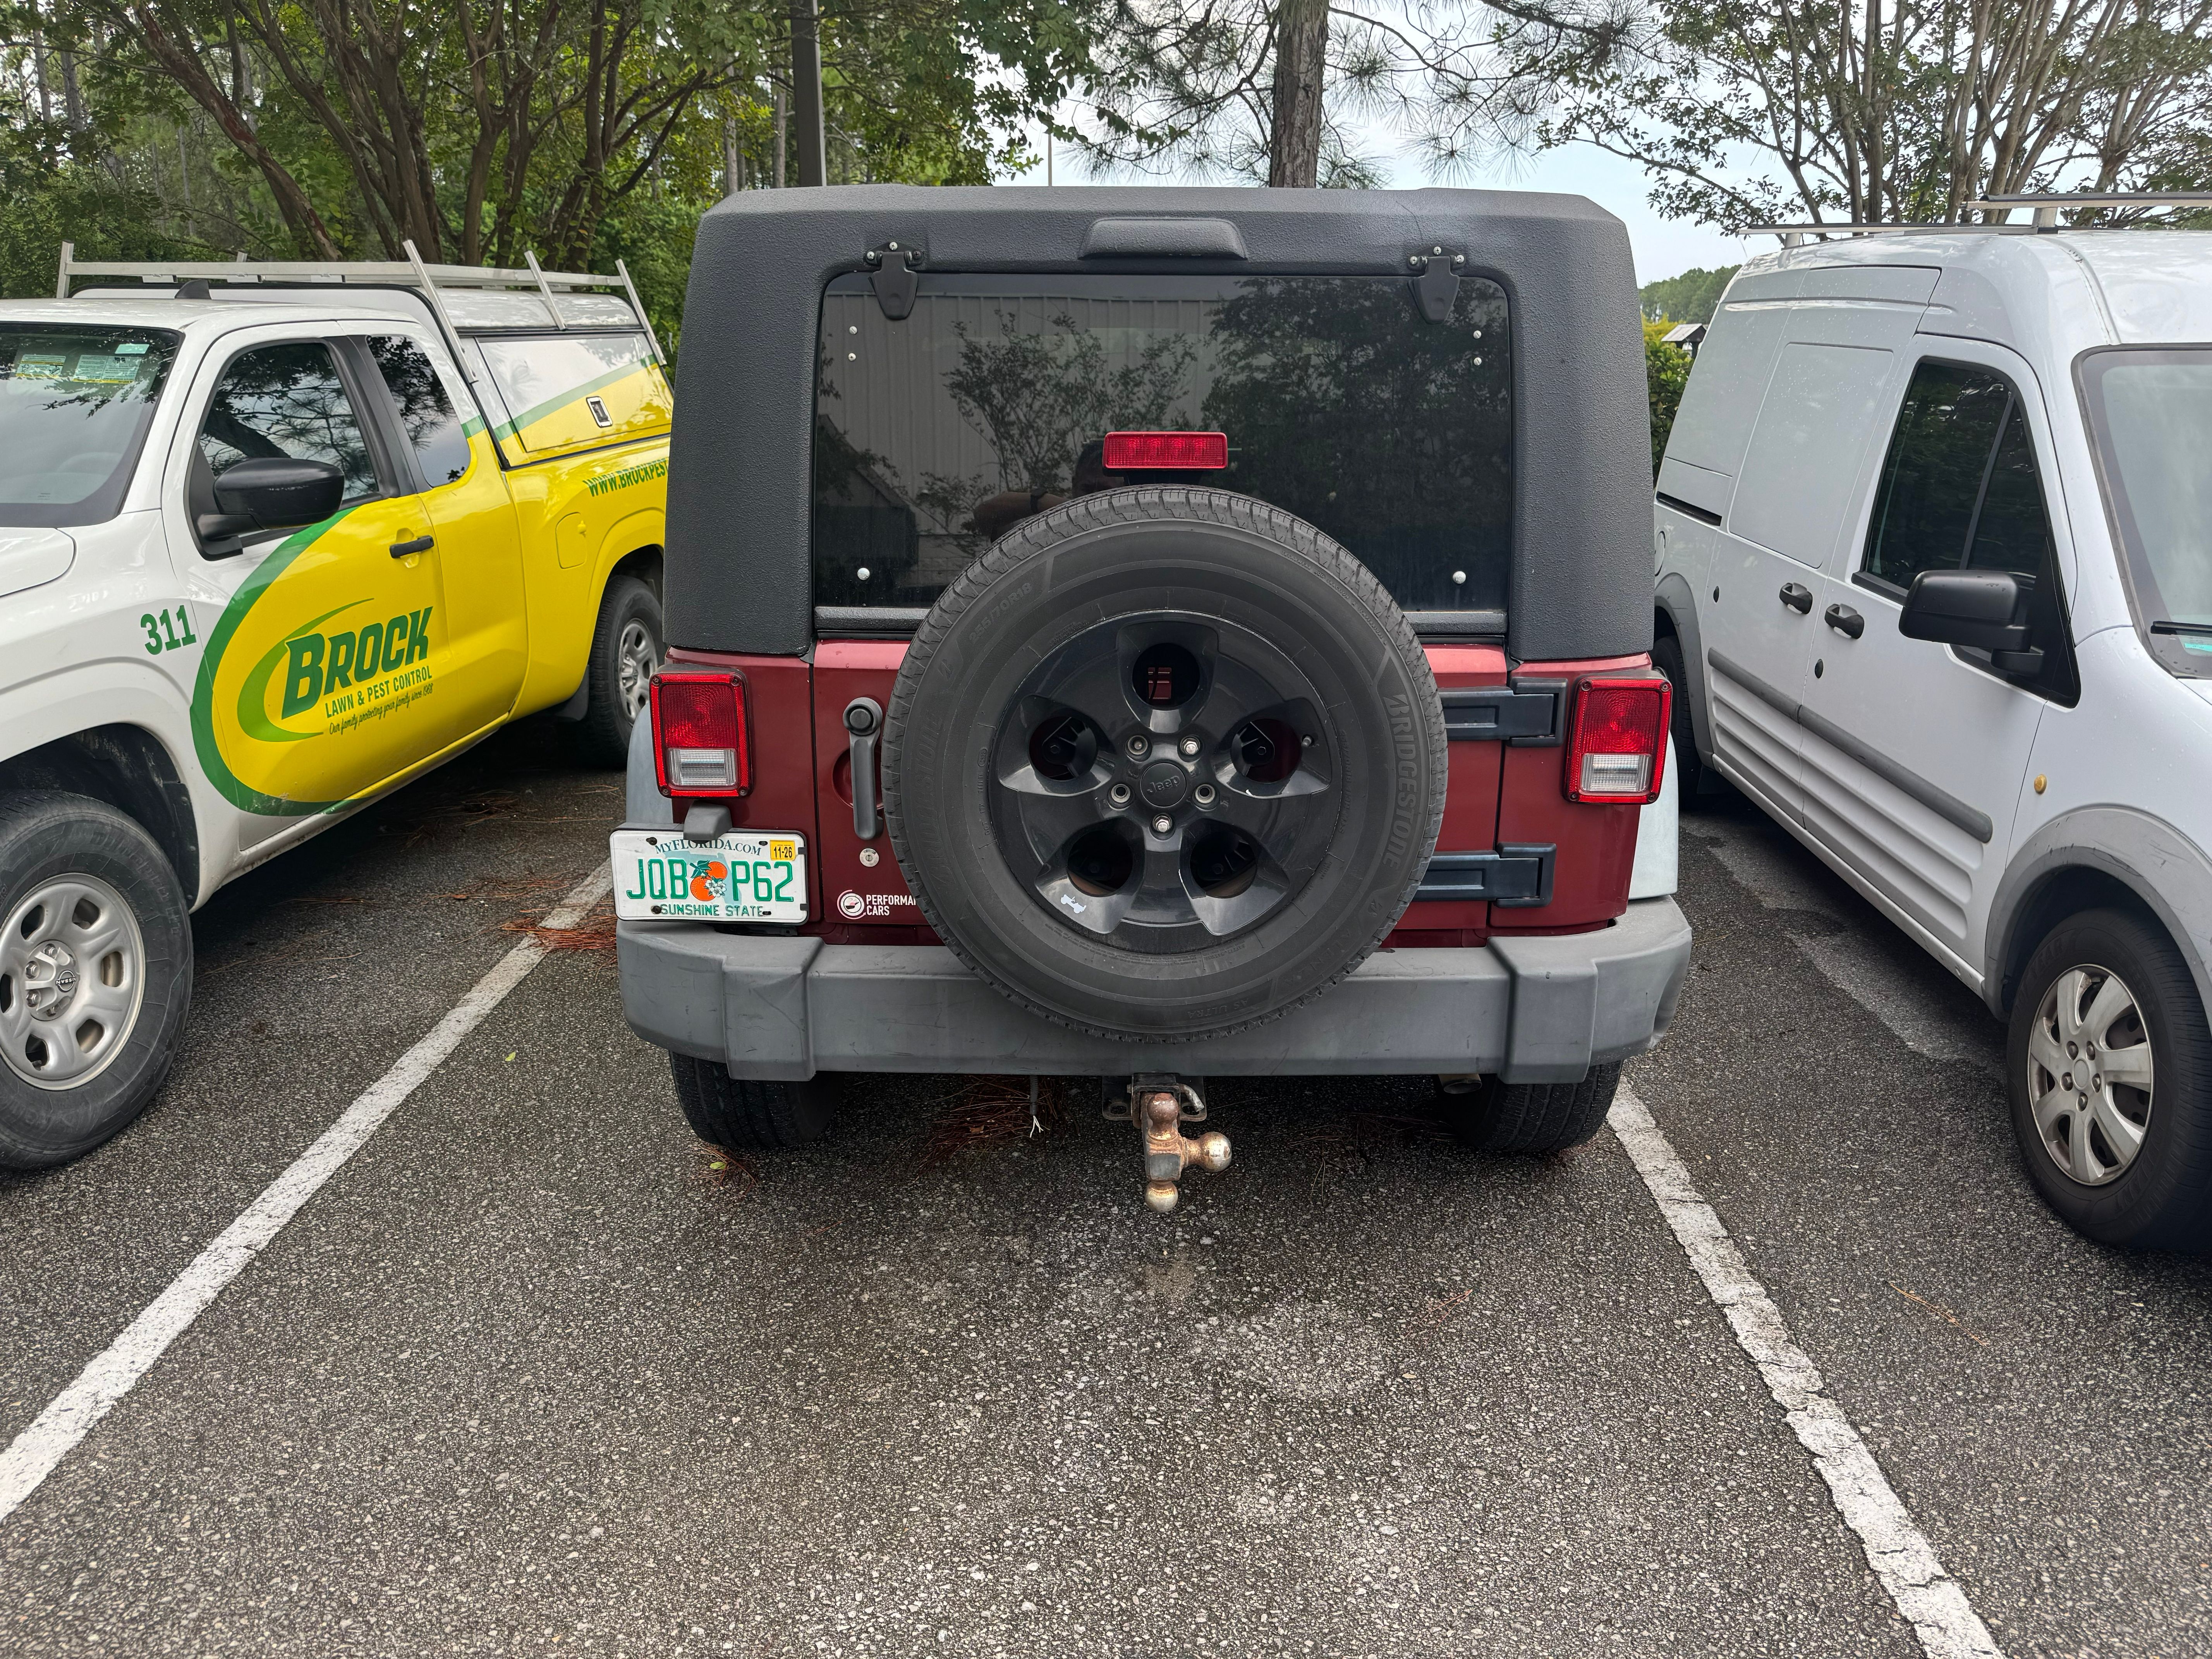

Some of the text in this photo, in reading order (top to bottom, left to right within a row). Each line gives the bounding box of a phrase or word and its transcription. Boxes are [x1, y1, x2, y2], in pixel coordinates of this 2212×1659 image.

[141, 605, 196, 655] 311
[282, 606, 433, 720] BROCK
[325, 665, 432, 718] LAWN & PEST CONTROL
[329, 722, 340, 735] Our
[340, 713, 358, 735] family
[358, 706, 383, 726] protecting
[383, 701, 395, 718] your
[395, 692, 410, 713] family
[411, 690, 422, 701] since
[1147, 775, 1181, 793] Jeep
[1382, 693, 1418, 871] BRIDGESTONE
[774, 846, 792, 859] 11-26
[626, 859, 794, 902] JQB P62
[866, 894, 916, 906] PERFORMA
[660, 903, 763, 917] SUNSHINE STATE
[866, 905, 890, 916] CARS
